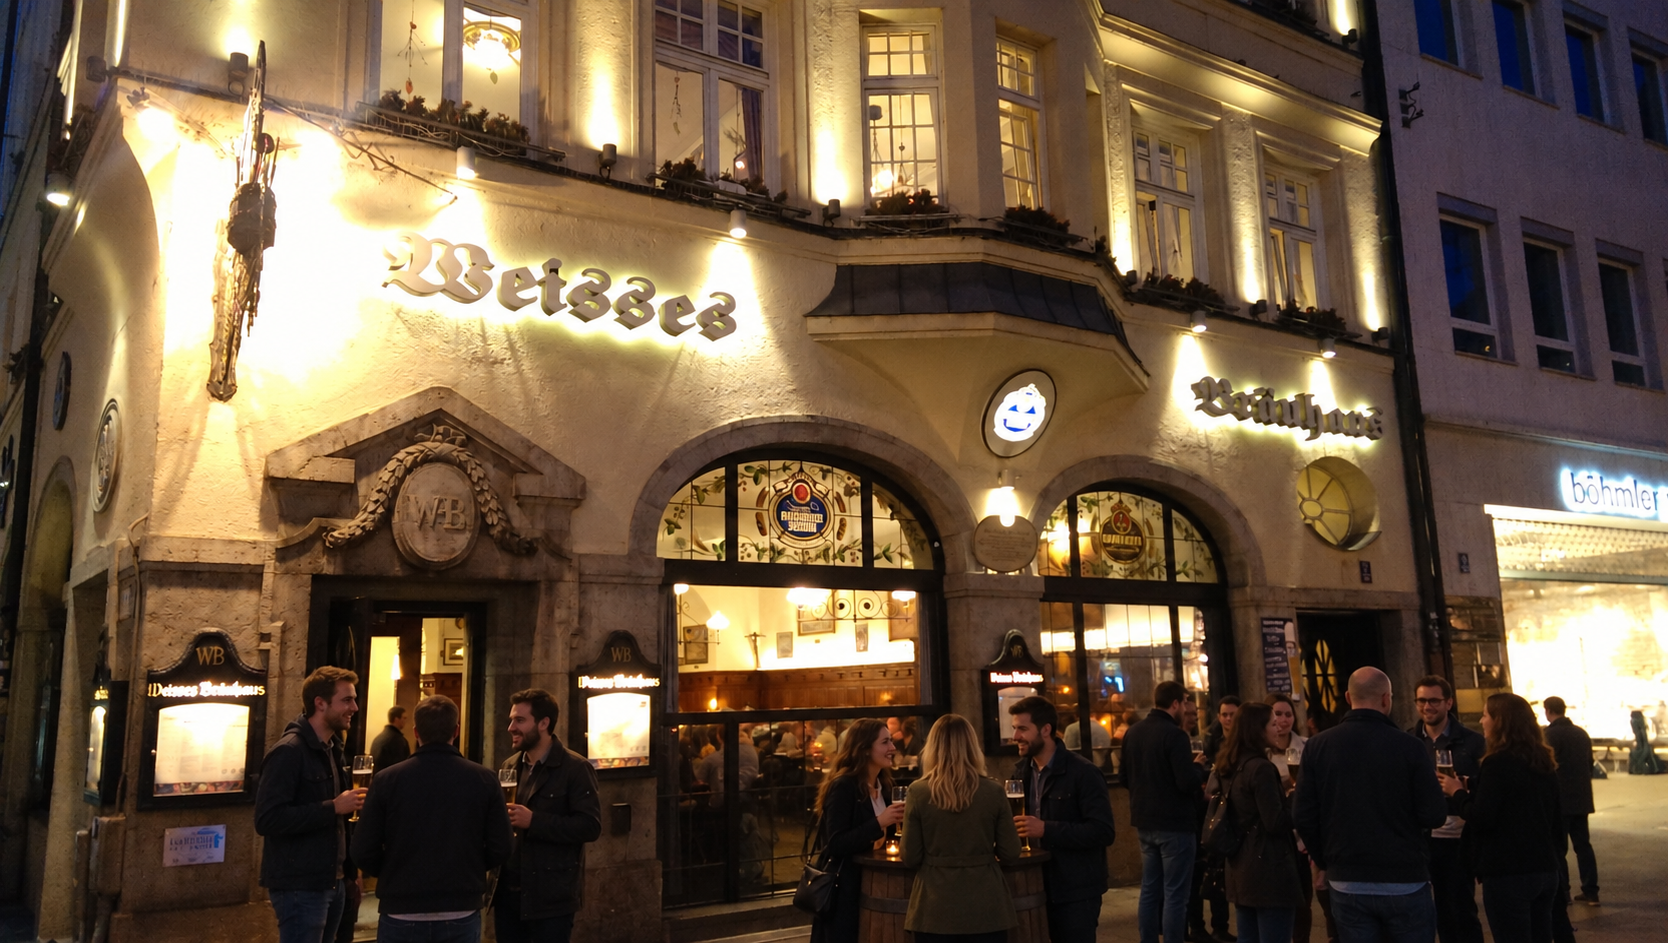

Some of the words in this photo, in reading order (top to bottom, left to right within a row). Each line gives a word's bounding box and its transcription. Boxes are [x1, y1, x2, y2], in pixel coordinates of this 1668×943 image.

[382, 231, 737, 342] Weisses
[1191, 376, 1384, 441] Bräuhaus
[1570, 471, 1658, 511] böhmler
[196, 646, 225, 665] WB
[611, 647, 632, 662] WB
